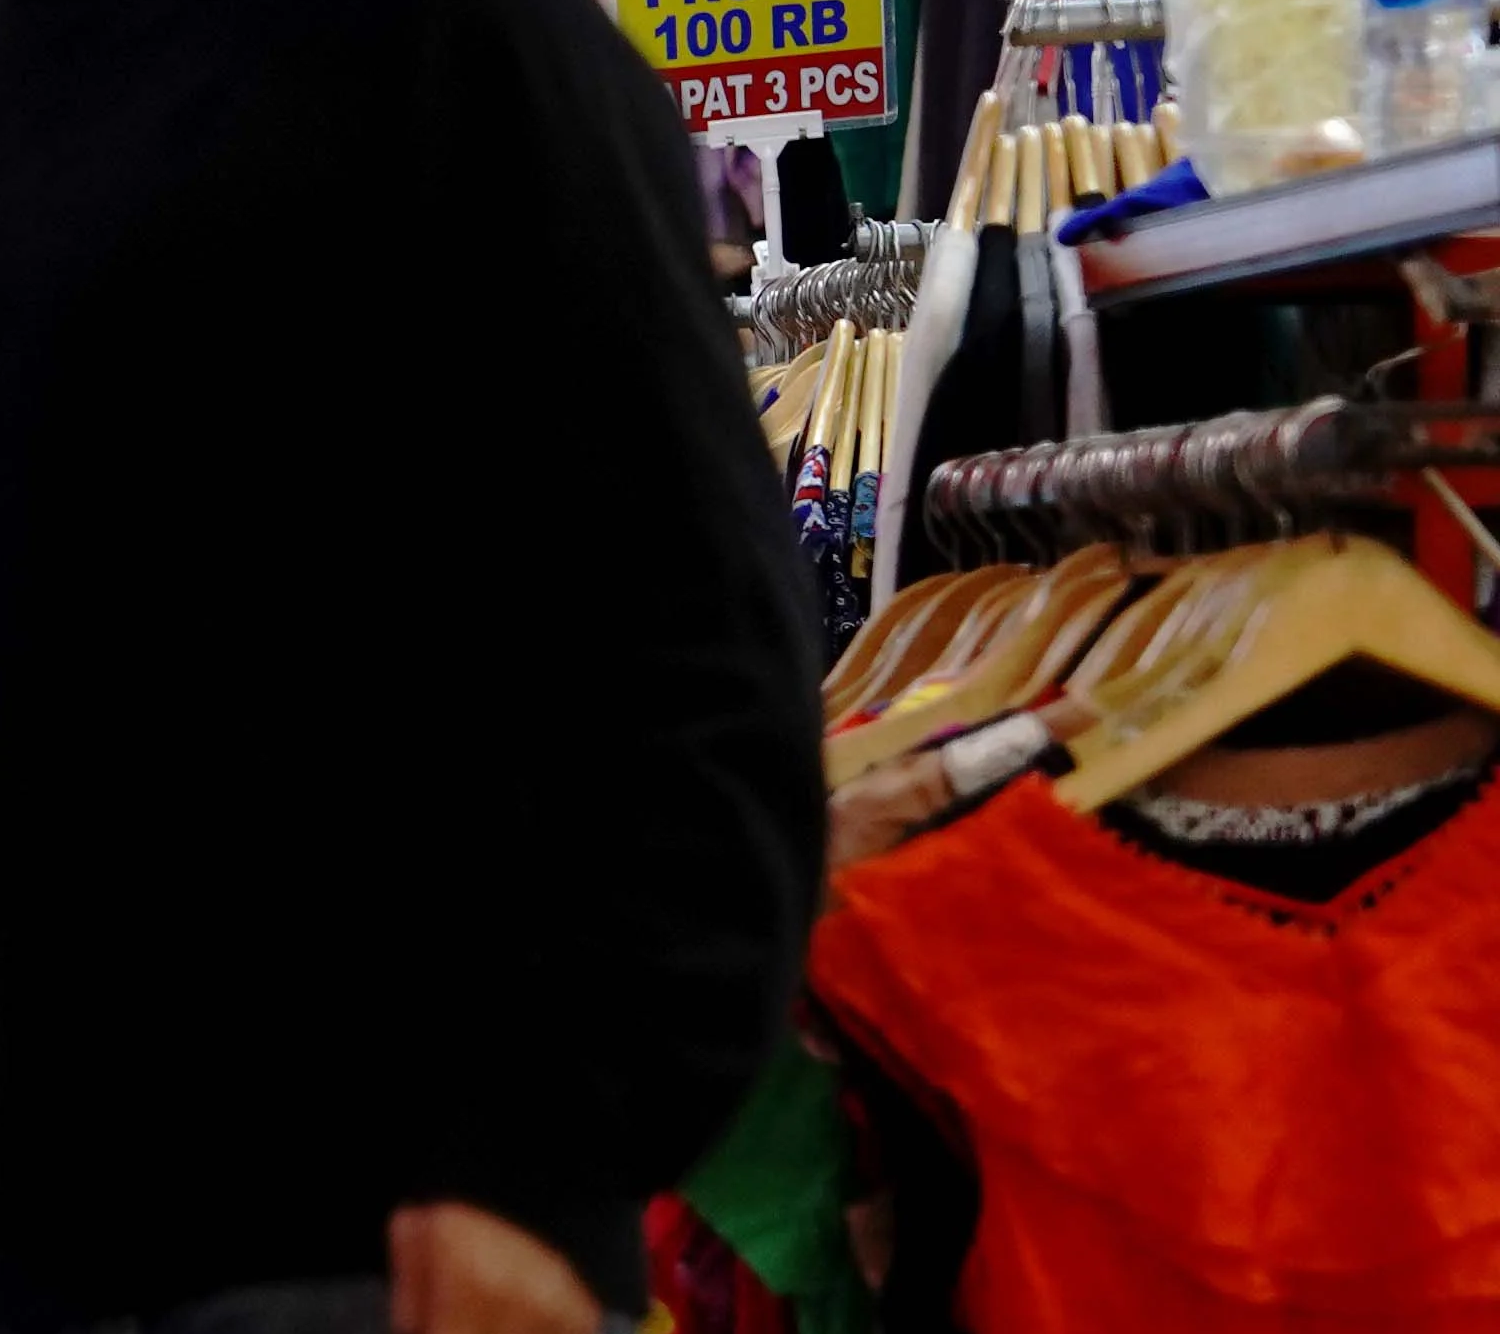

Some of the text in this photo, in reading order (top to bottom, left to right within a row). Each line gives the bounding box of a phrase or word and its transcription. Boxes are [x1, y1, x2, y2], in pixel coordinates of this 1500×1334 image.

[654, 0, 848, 60] 100 RB
[664, 61, 880, 120] PAT 3 PCS
